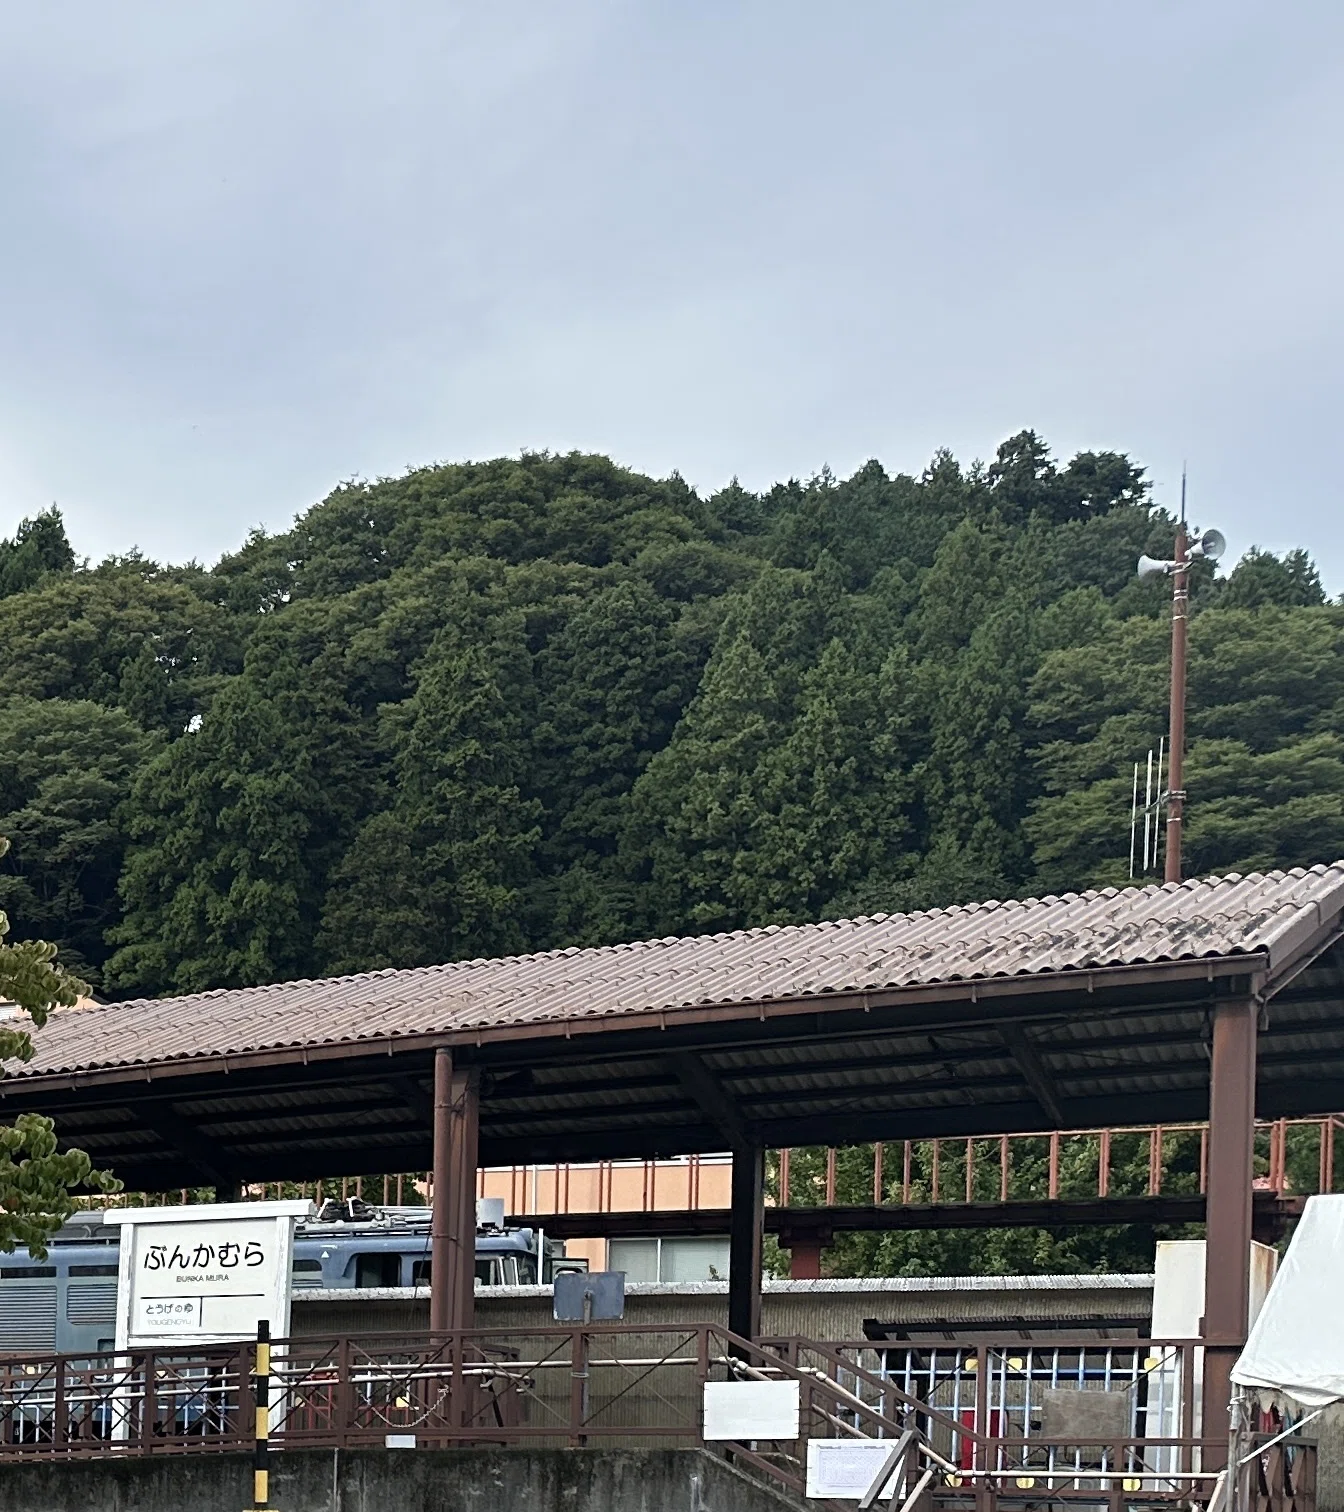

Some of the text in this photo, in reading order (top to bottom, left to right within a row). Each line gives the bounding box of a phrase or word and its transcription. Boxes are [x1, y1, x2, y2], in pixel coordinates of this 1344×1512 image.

[144, 1242, 264, 1270] ぶんかむら
[206, 1274, 229, 1282] MURA
[146, 1303, 194, 1315] とうげのゆ
